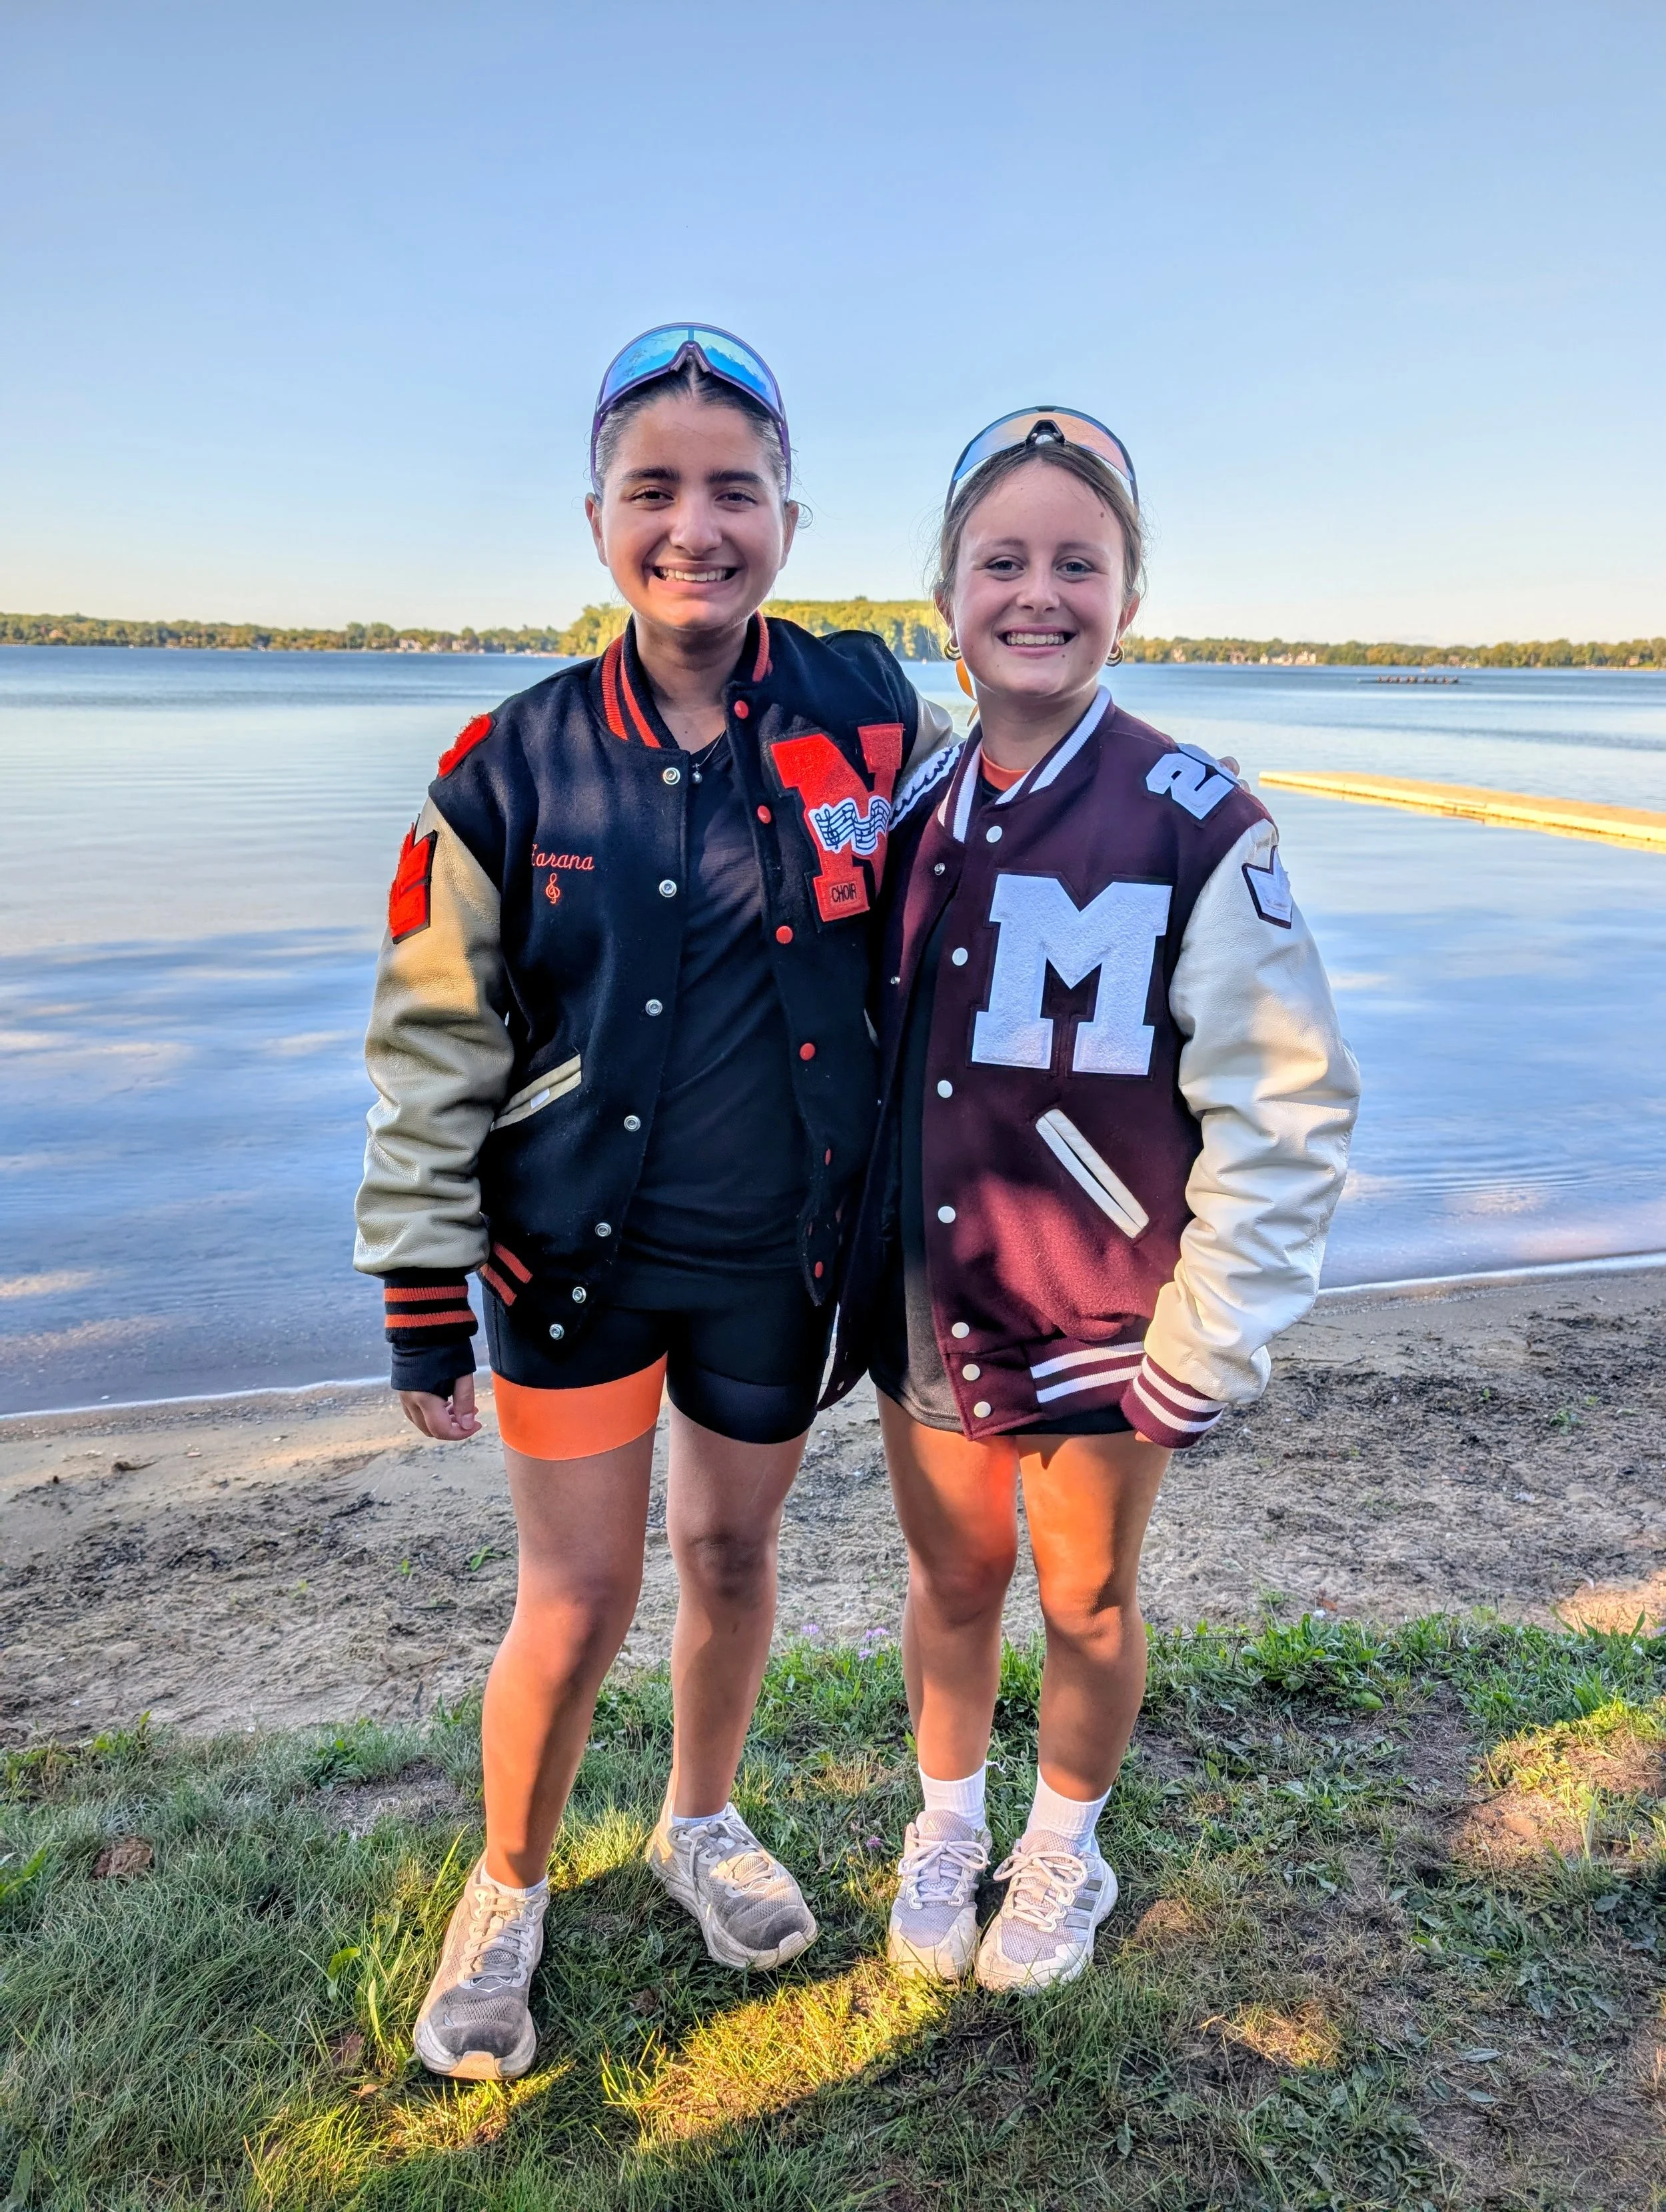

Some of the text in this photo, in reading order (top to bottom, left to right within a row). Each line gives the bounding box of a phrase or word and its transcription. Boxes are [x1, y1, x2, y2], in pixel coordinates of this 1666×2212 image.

[771, 723, 904, 922] N
[831, 882, 858, 903] CHOIR
[972, 874, 1172, 1075] M
